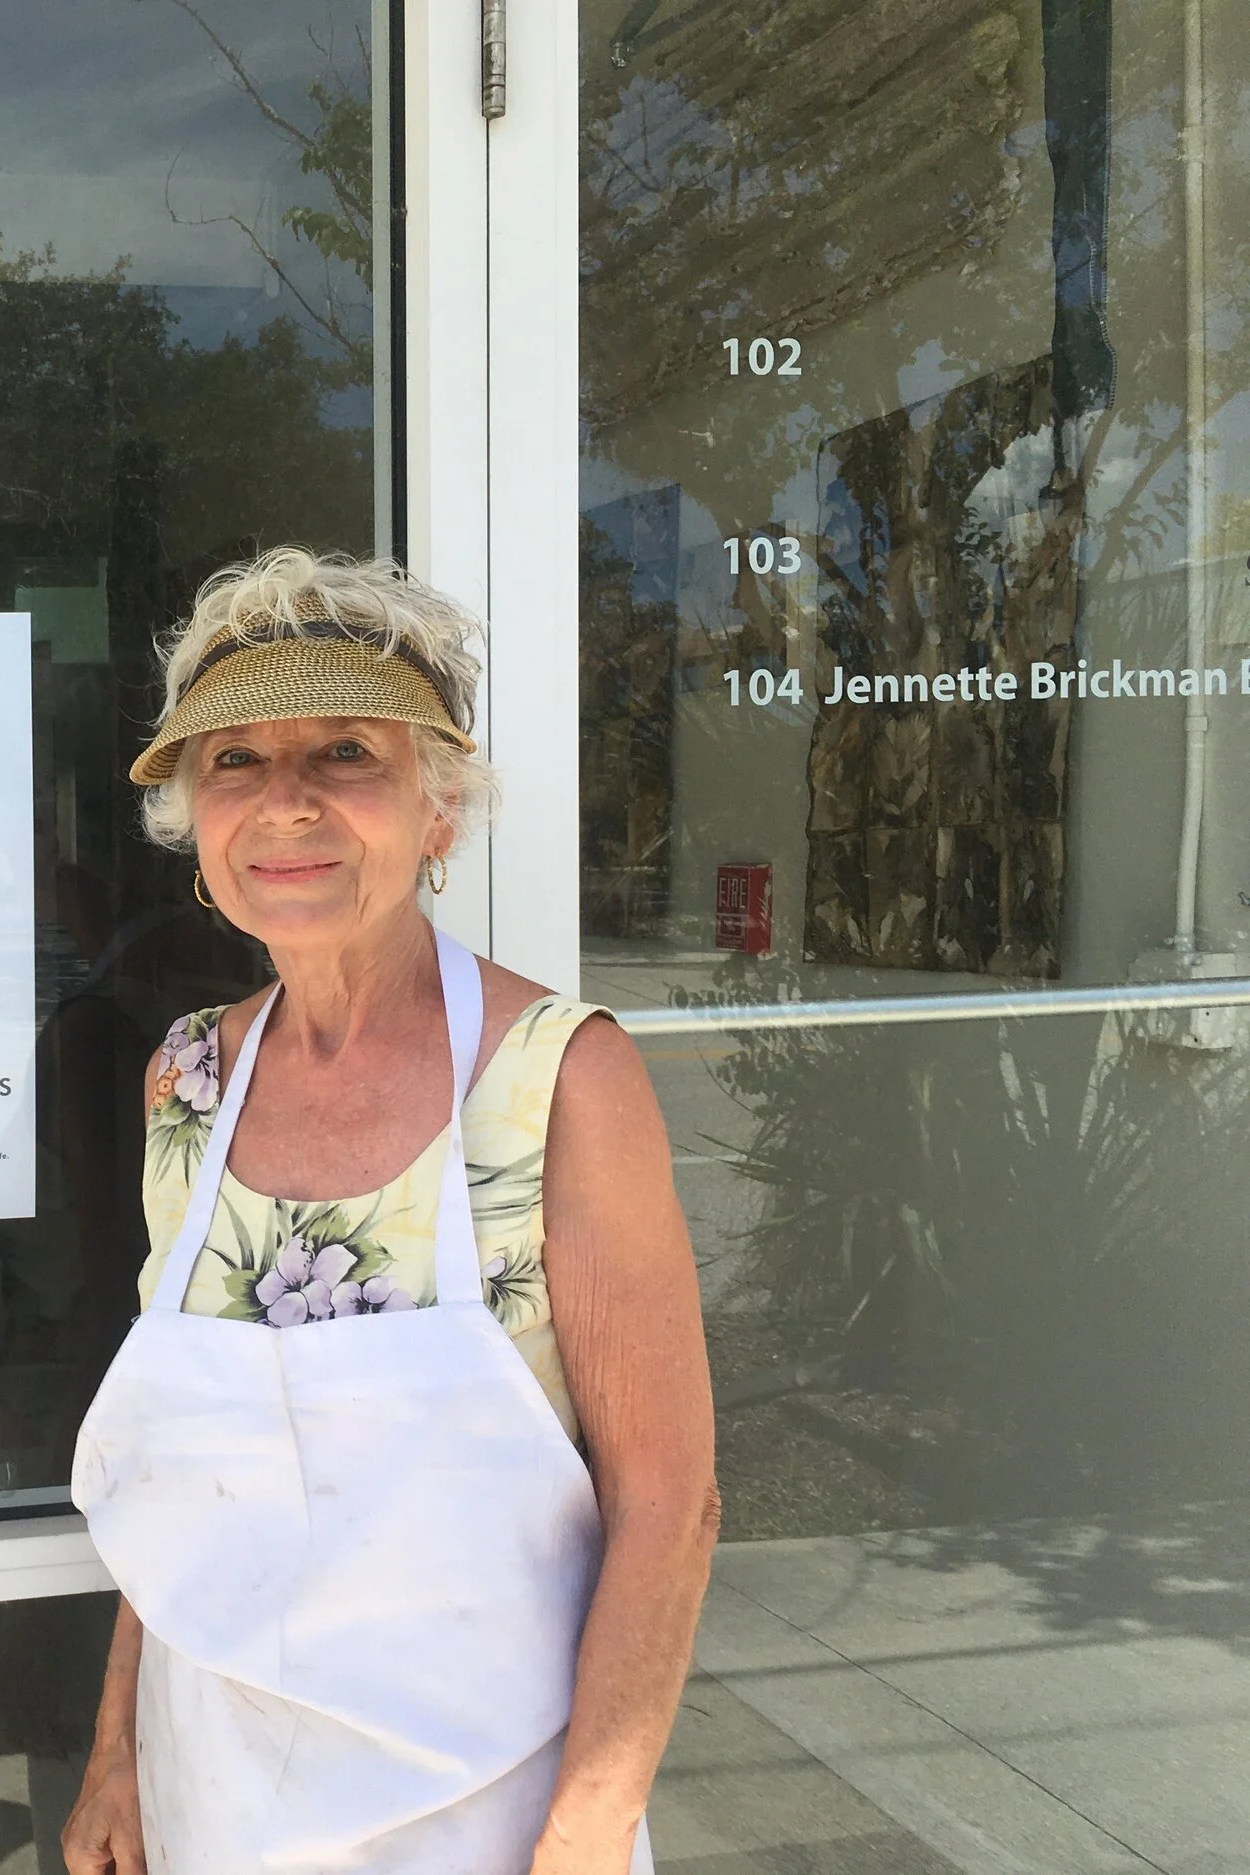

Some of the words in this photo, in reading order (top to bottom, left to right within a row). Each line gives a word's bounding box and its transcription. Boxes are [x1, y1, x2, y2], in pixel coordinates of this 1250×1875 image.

[722, 338, 802, 376] 102
[723, 537, 802, 575] 103
[723, 668, 803, 706] 104
[824, 666, 1018, 705] Jennette
[1031, 659, 1227, 699] Brickman
[718, 877, 747, 910] FIRE
